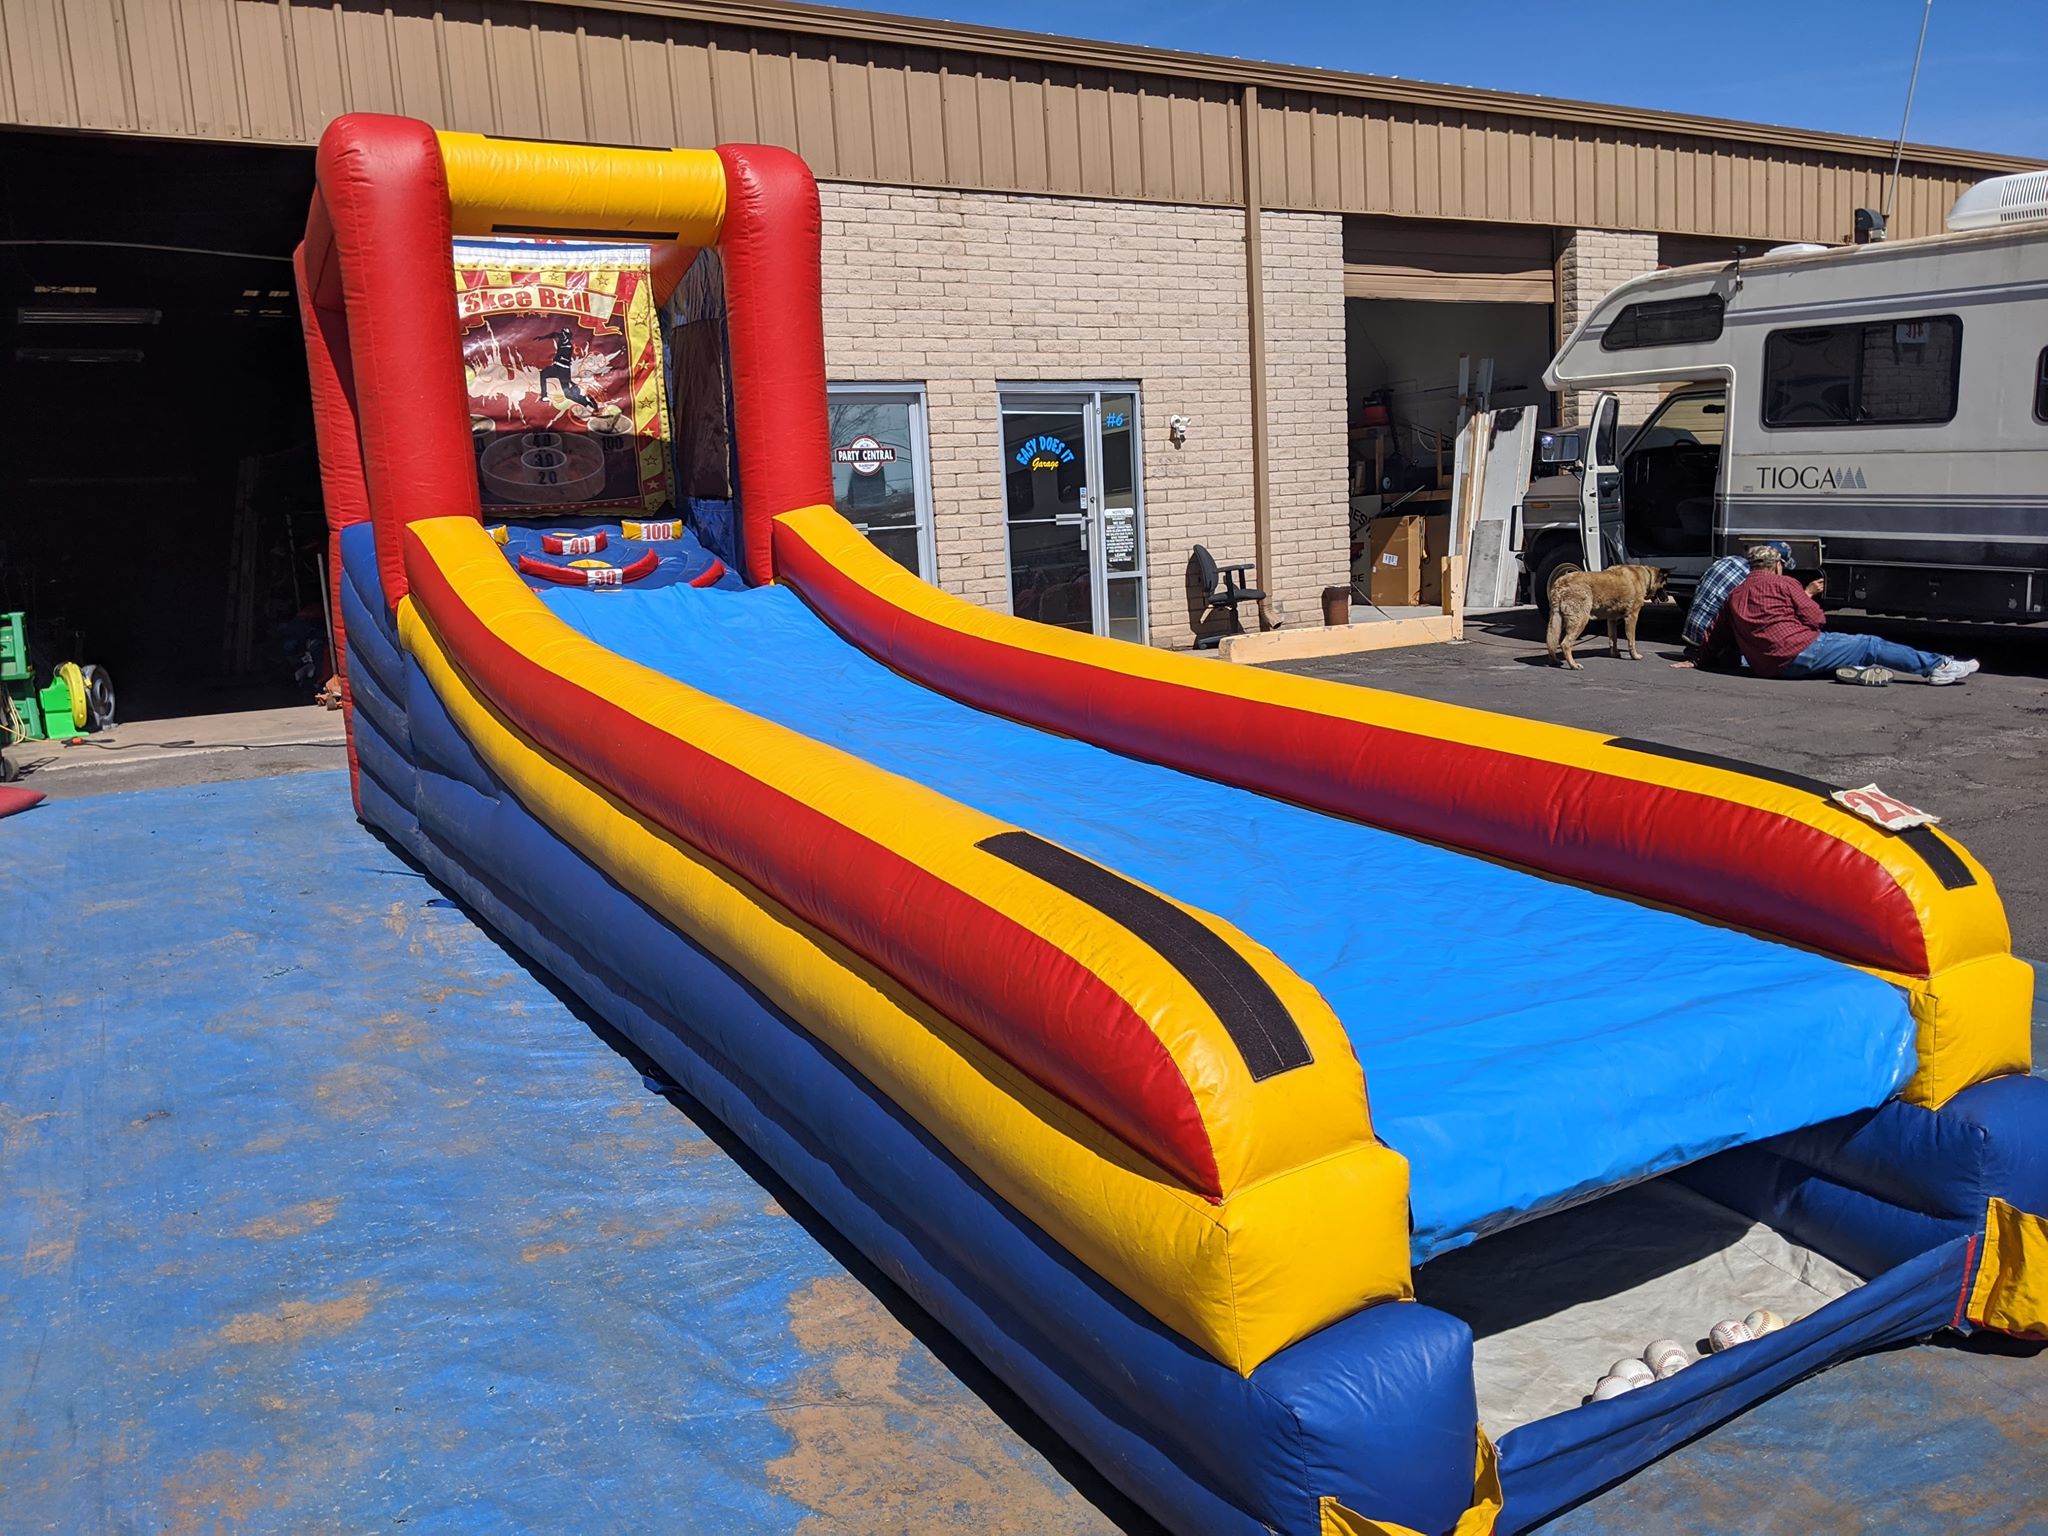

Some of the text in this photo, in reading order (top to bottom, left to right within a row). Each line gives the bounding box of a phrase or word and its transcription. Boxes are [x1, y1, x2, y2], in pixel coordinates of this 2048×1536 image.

[464, 288, 591, 313] Skee Ball
[1106, 411, 1124, 428] #6
[838, 449, 894, 461] PARTY CENTRAL
[1016, 435, 1075, 466] EASY DOES IT
[534, 453, 554, 467] 30
[1032, 457, 1060, 471] Garage
[538, 471, 558, 484] 20
[1756, 466, 1837, 490] TIOGA
[643, 523, 671, 540] 100
[570, 538, 590, 554] 40
[594, 570, 617, 586] 30
